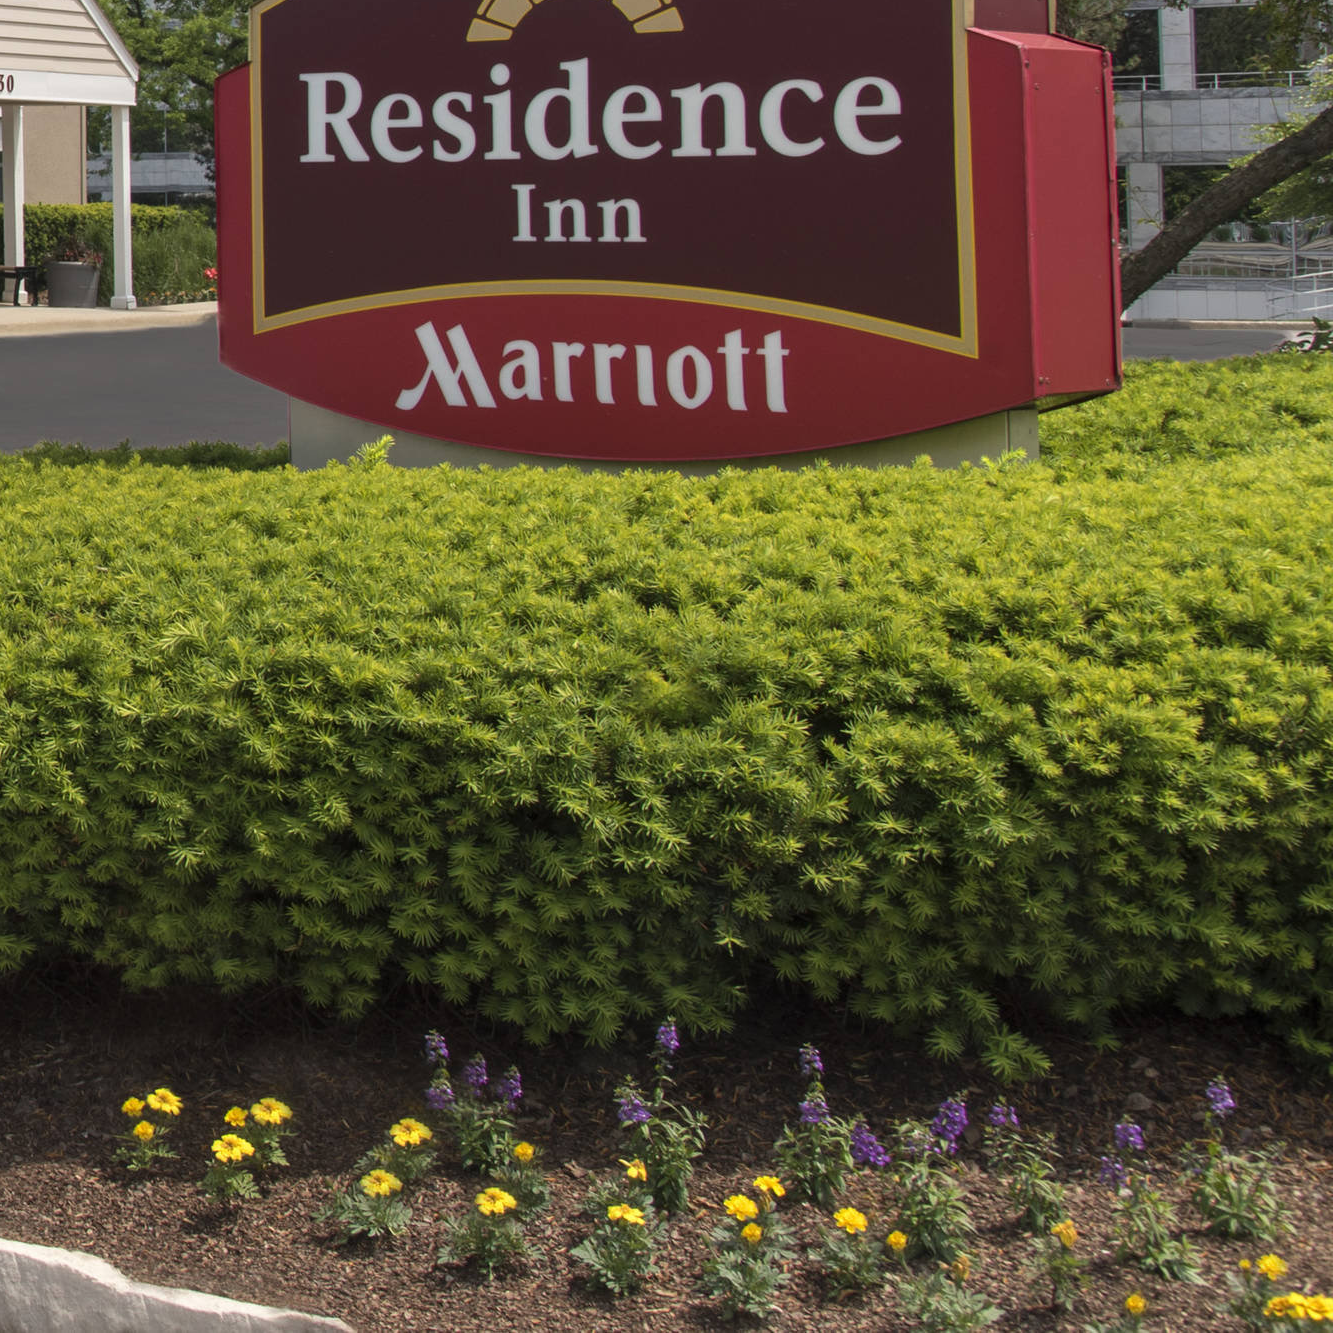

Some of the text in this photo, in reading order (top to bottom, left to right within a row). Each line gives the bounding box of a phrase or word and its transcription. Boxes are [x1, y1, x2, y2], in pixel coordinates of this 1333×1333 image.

[299, 57, 902, 163] Residence
[511, 184, 647, 243] Inn
[395, 321, 790, 413] Marriott
